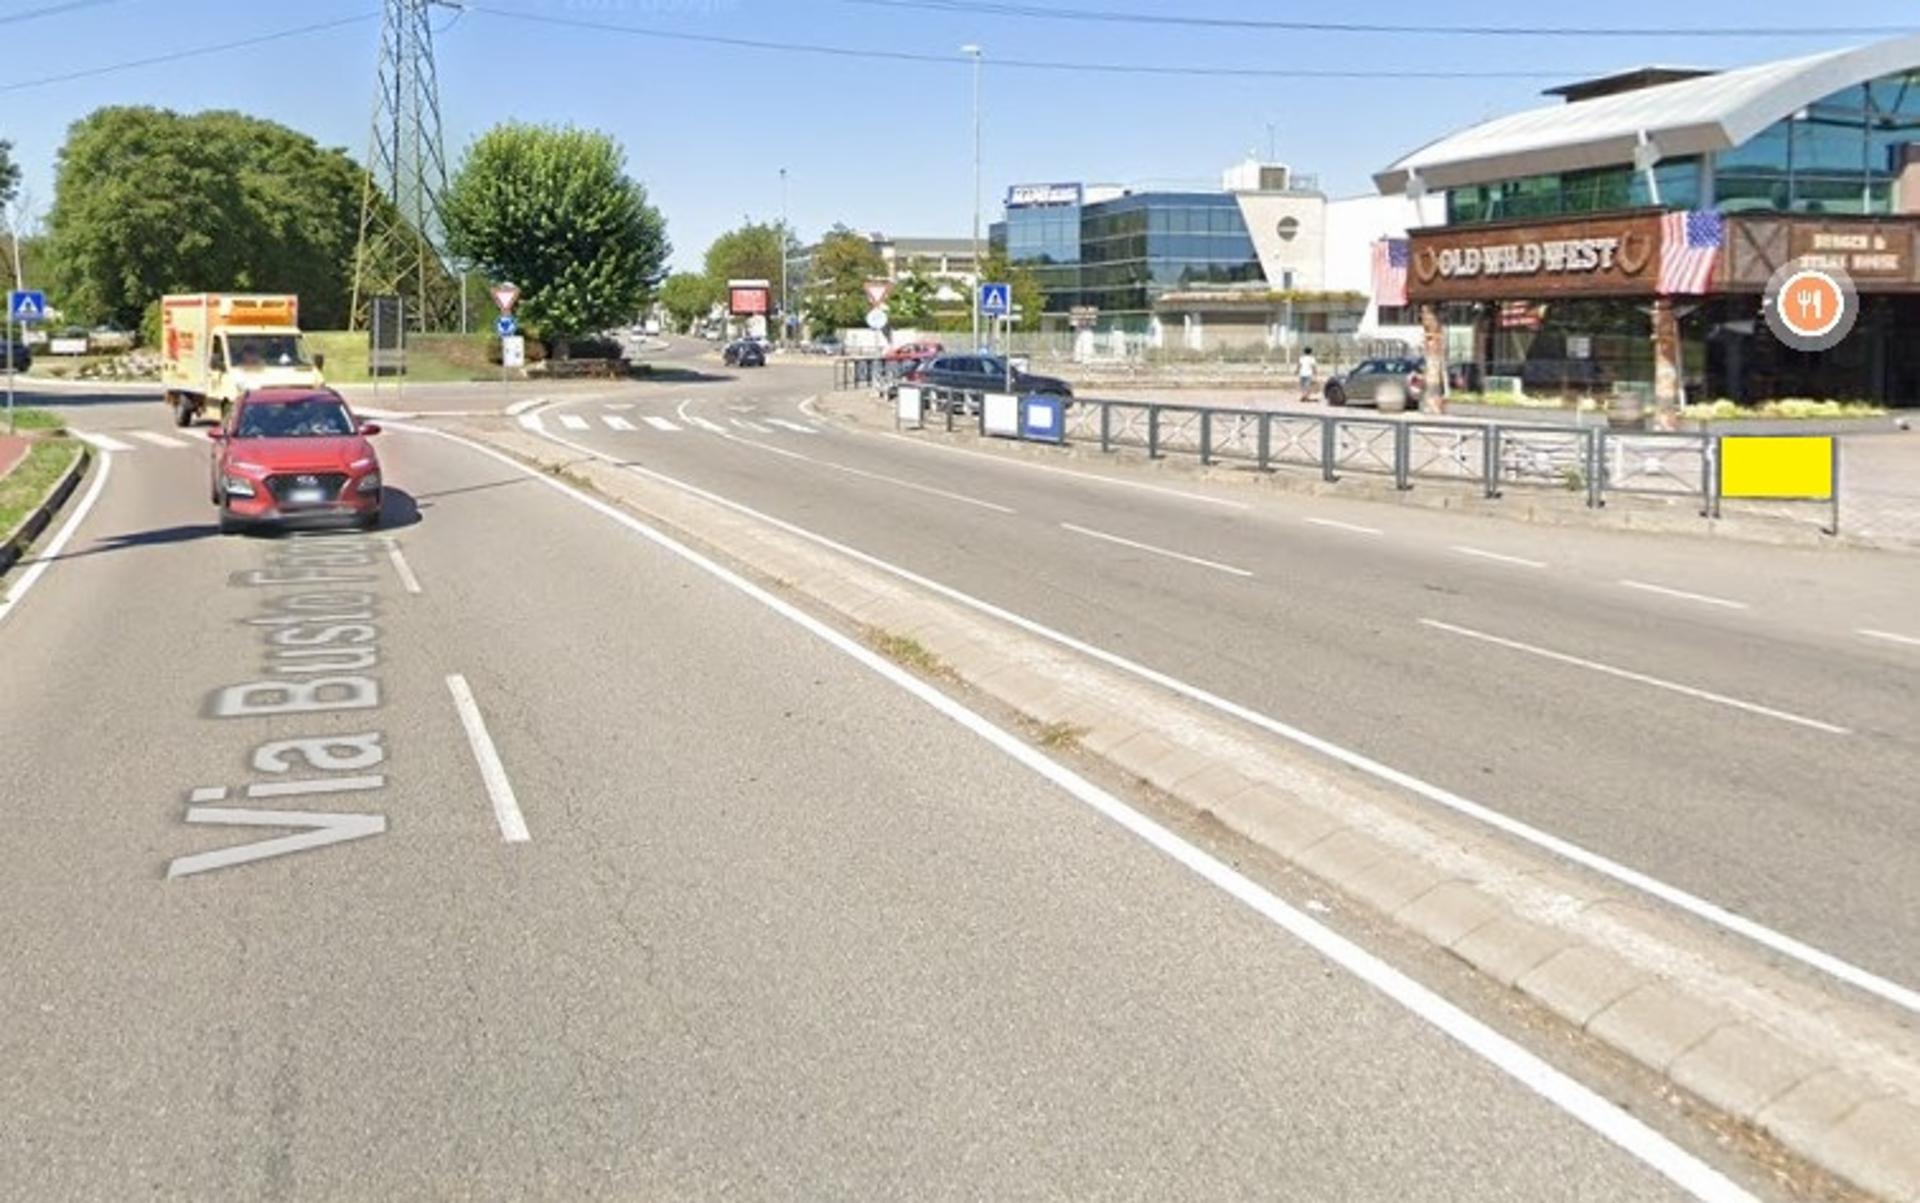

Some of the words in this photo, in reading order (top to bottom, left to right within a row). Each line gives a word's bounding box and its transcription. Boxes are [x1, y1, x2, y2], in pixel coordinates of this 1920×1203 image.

[1438, 246, 1480, 276] OLD
[1482, 242, 1541, 274] WILD
[1543, 237, 1618, 271] WEST
